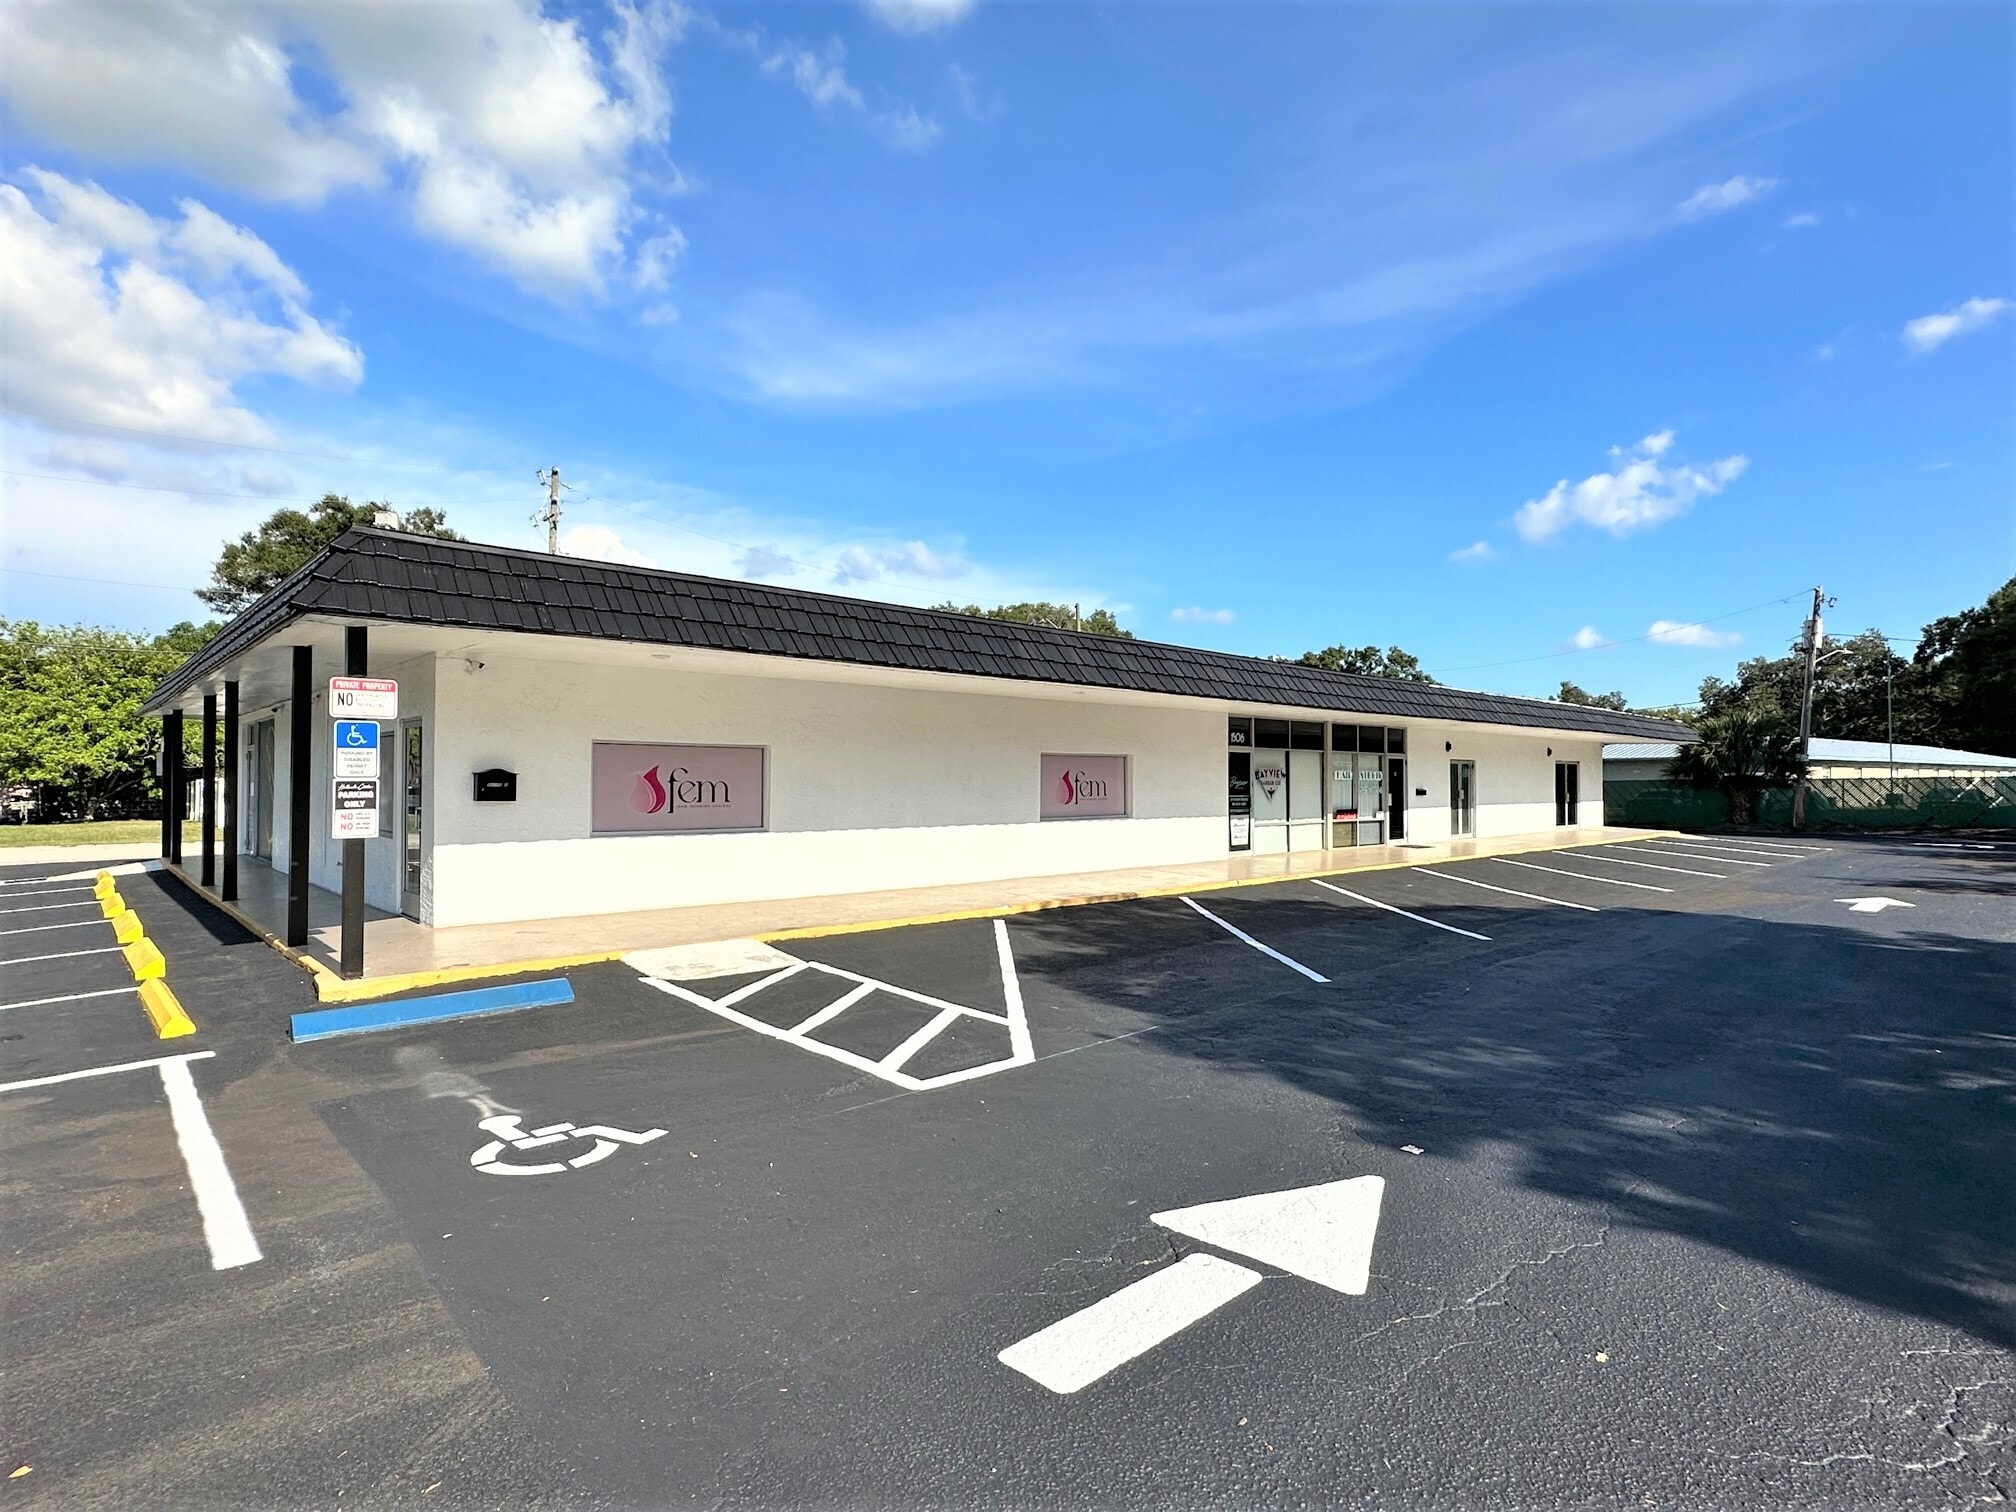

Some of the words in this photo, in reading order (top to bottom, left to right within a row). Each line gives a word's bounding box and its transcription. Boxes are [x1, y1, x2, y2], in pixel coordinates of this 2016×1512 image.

[335, 680, 360, 690] PRIVATE
[361, 682, 393, 691] PROPERTY
[337, 692, 354, 706] NO
[1254, 768, 1286, 780] BAYVIEW
[668, 767, 731, 813] fem
[1075, 770, 1107, 805] fem
[337, 790, 375, 799] PARKING
[343, 800, 366, 808] ONLY
[340, 813, 354, 821] NO
[340, 823, 354, 831] NO
